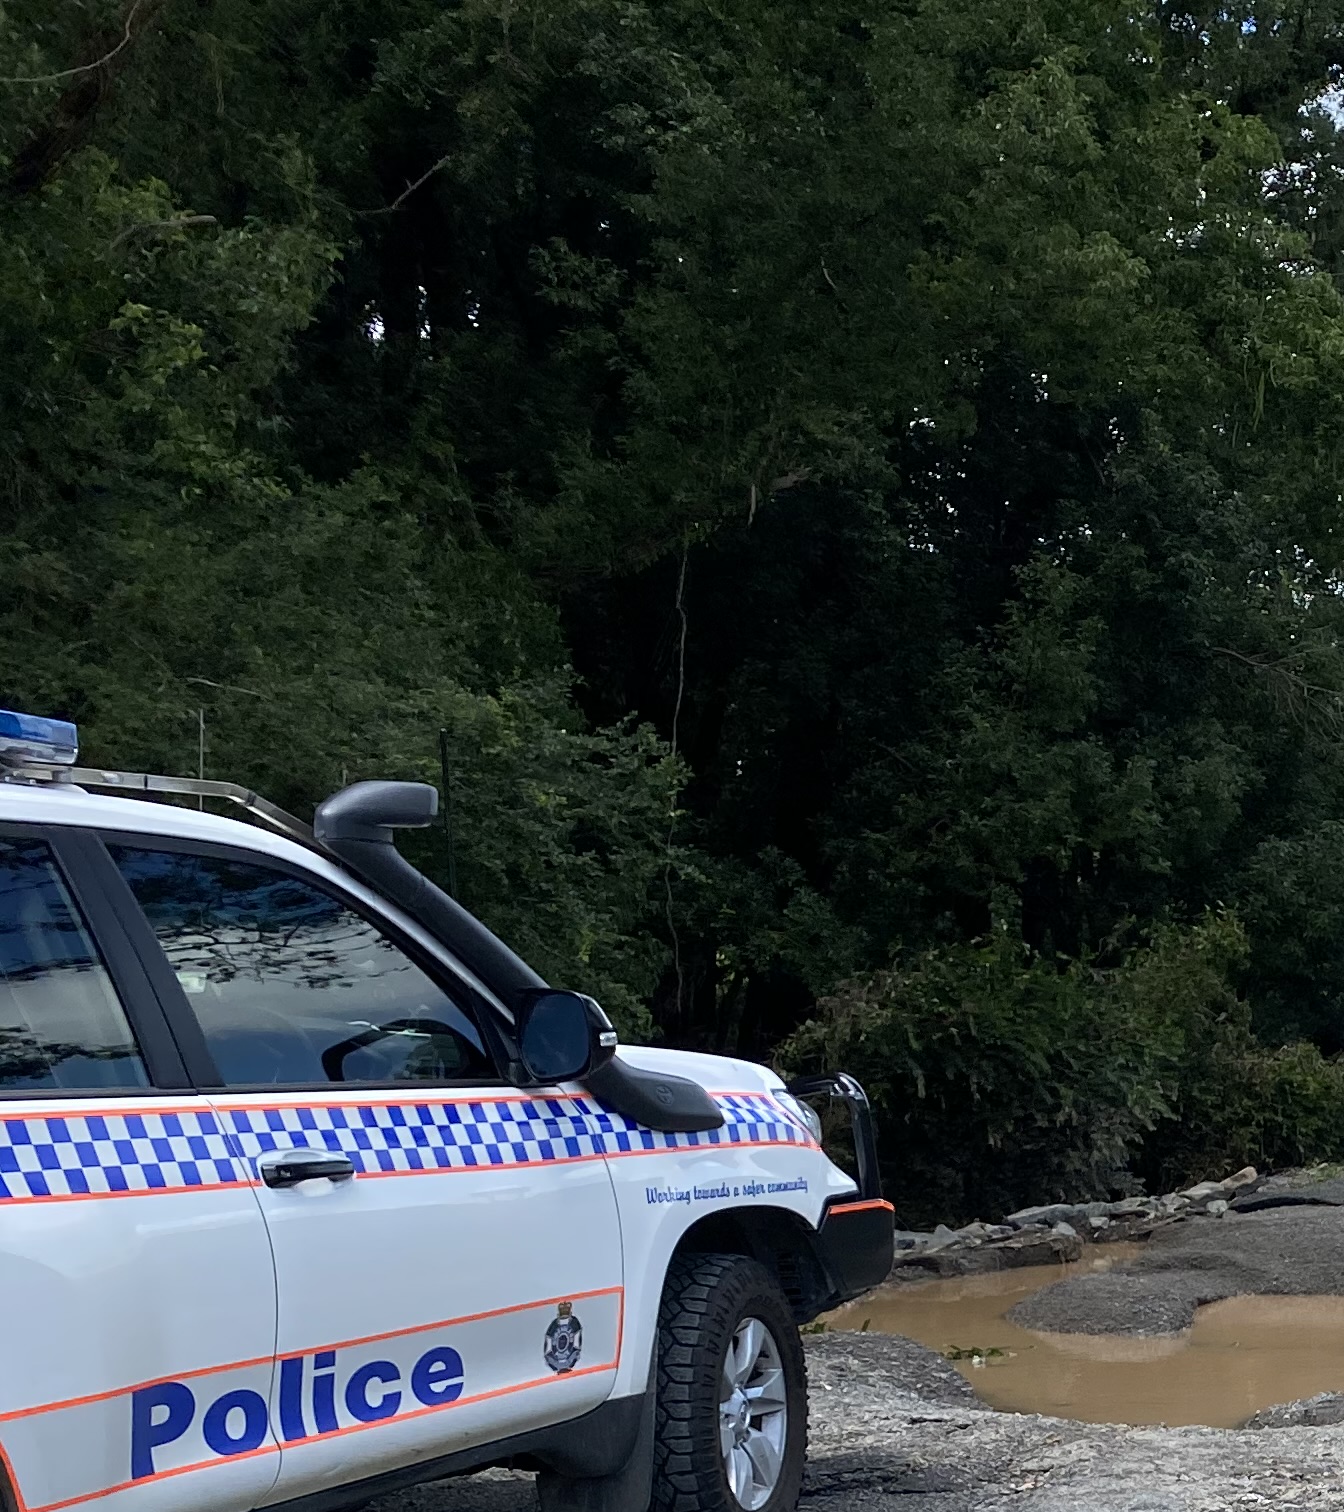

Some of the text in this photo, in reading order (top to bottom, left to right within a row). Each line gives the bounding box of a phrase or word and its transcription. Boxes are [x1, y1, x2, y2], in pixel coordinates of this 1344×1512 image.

[645, 1176, 809, 1205] Working towards a safer community
[131, 1346, 464, 1480] Police
